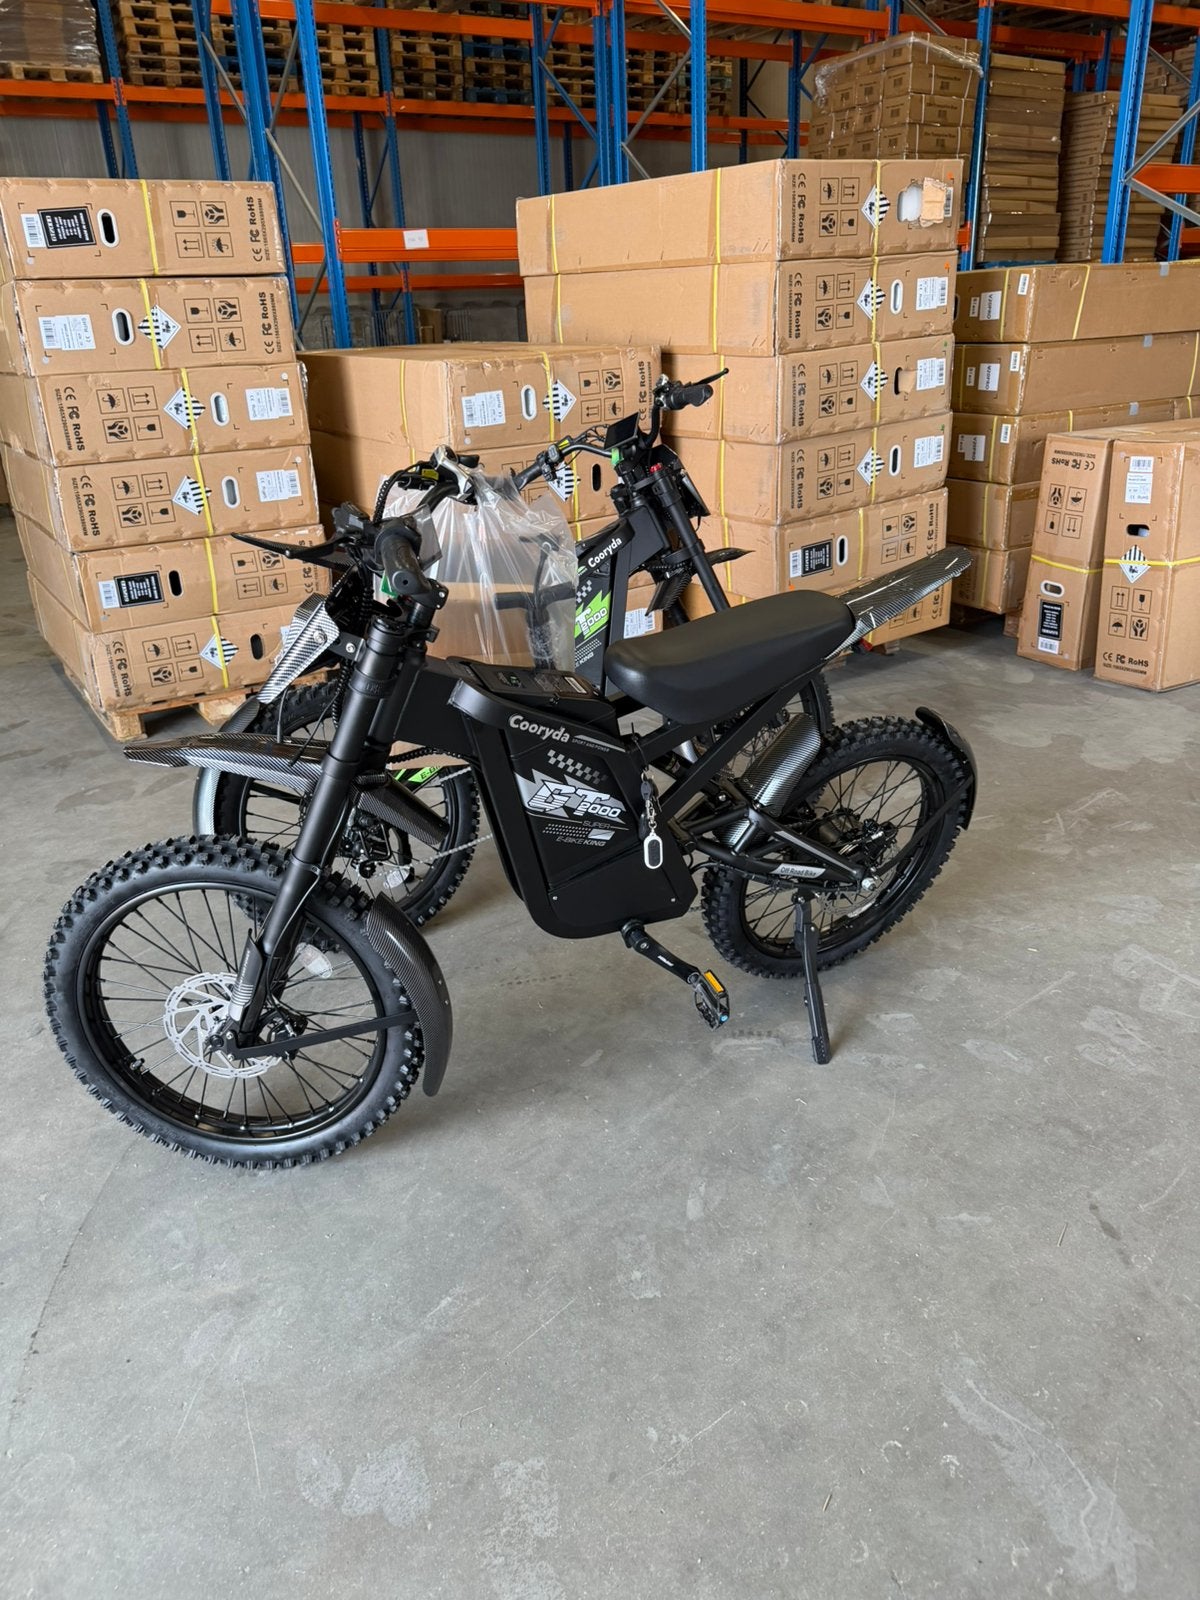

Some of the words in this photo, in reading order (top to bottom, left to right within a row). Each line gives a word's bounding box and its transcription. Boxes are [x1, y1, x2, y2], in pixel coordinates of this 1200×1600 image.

[246, 197, 257, 225] RoHS
[259, 292, 268, 319] RoHS
[73, 424, 85, 451] RoHS
[1051, 457, 1070, 466] RoHS
[89, 510, 100, 536] RoHS
[587, 537, 622, 568] Cooryda
[581, 607, 608, 632] 2000
[1128, 658, 1149, 668] RoHS
[121, 673, 132, 697] RoHS
[509, 714, 570, 743] Cooryda
[527, 780, 611, 812] GT
[573, 800, 621, 818] 2000
[582, 820, 611, 829] SUPER
[556, 837, 584, 845] E-BIKE
[583, 839, 607, 847] KING
